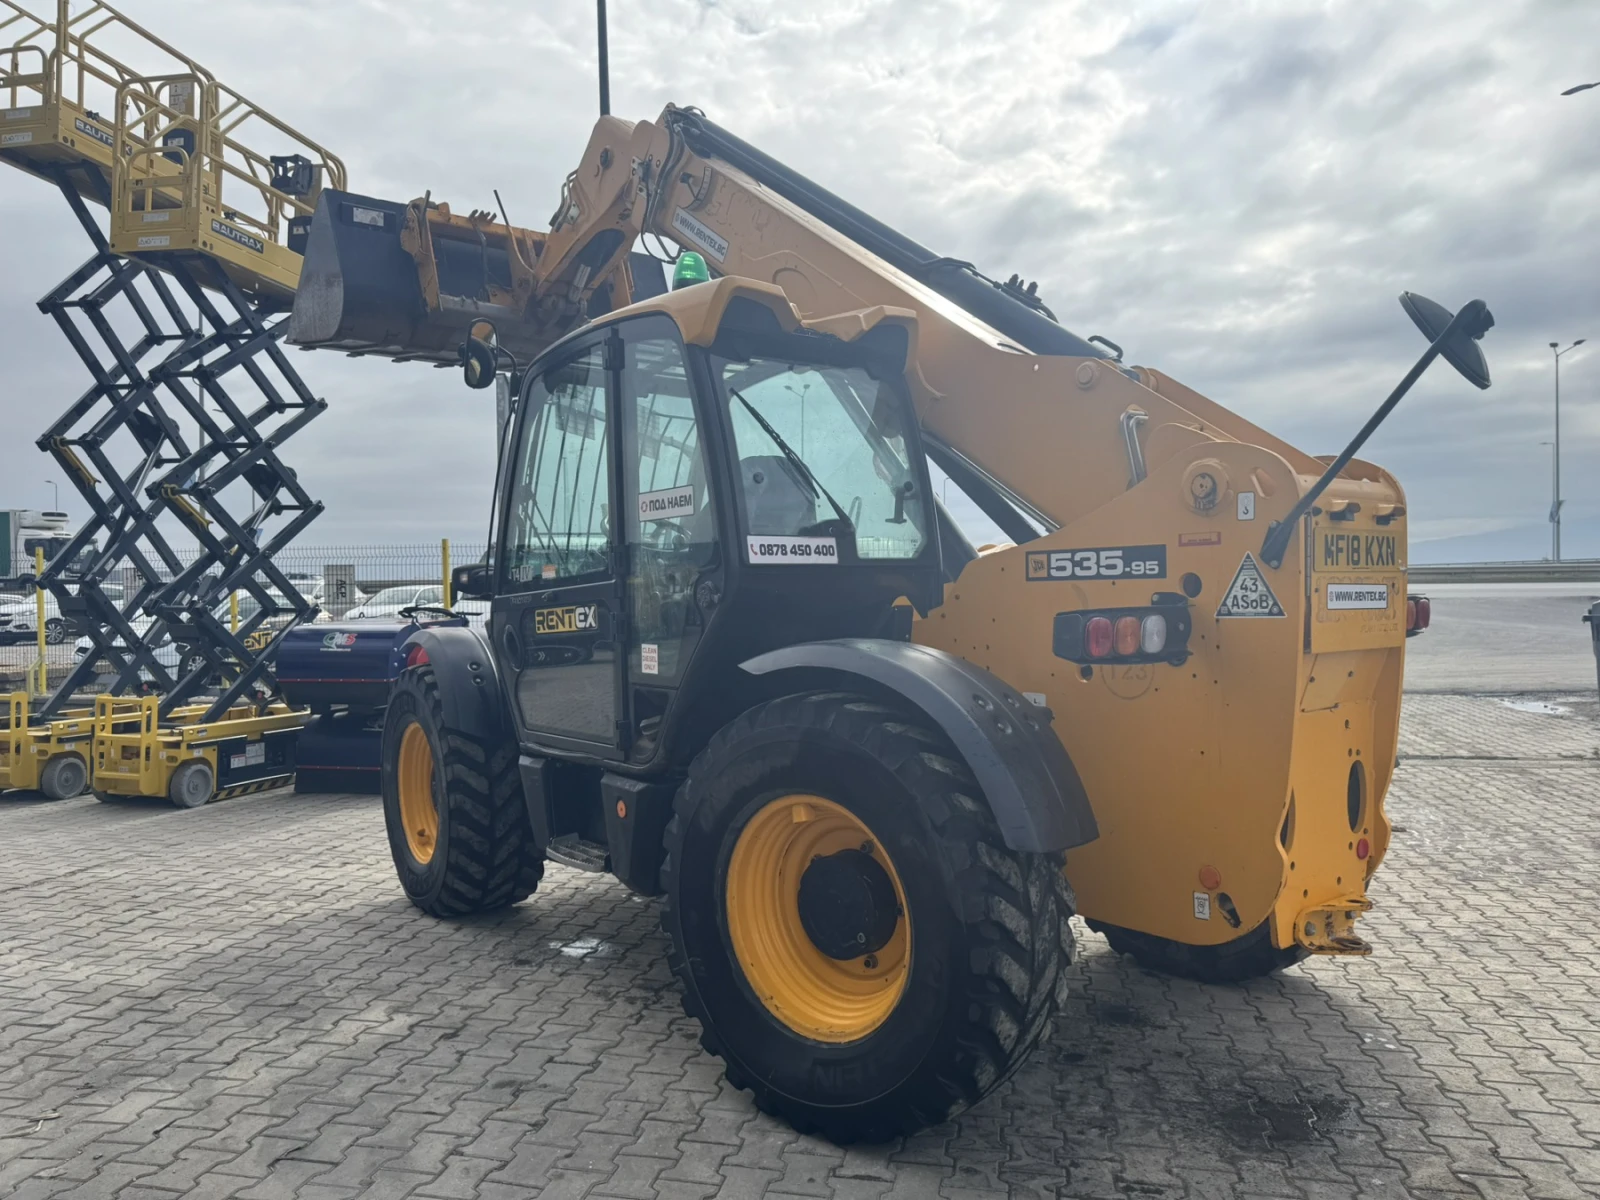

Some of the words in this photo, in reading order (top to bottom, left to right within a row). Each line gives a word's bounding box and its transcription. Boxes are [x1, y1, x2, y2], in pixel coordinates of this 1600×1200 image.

[212, 220, 263, 253] BAUTRAX
[648, 498, 667, 512] ПОД
[667, 493, 692, 510] НАЕМ
[759, 543, 788, 557] 0878
[789, 544, 812, 557] 450
[813, 544, 836, 557] 400
[1324, 534, 1361, 567] MF18
[1365, 535, 1396, 567] KXN
[1240, 577, 1258, 593] 43
[1334, 591, 1386, 602] WWW.RENTEX.BG
[536, 606, 597, 632] RENTEX
